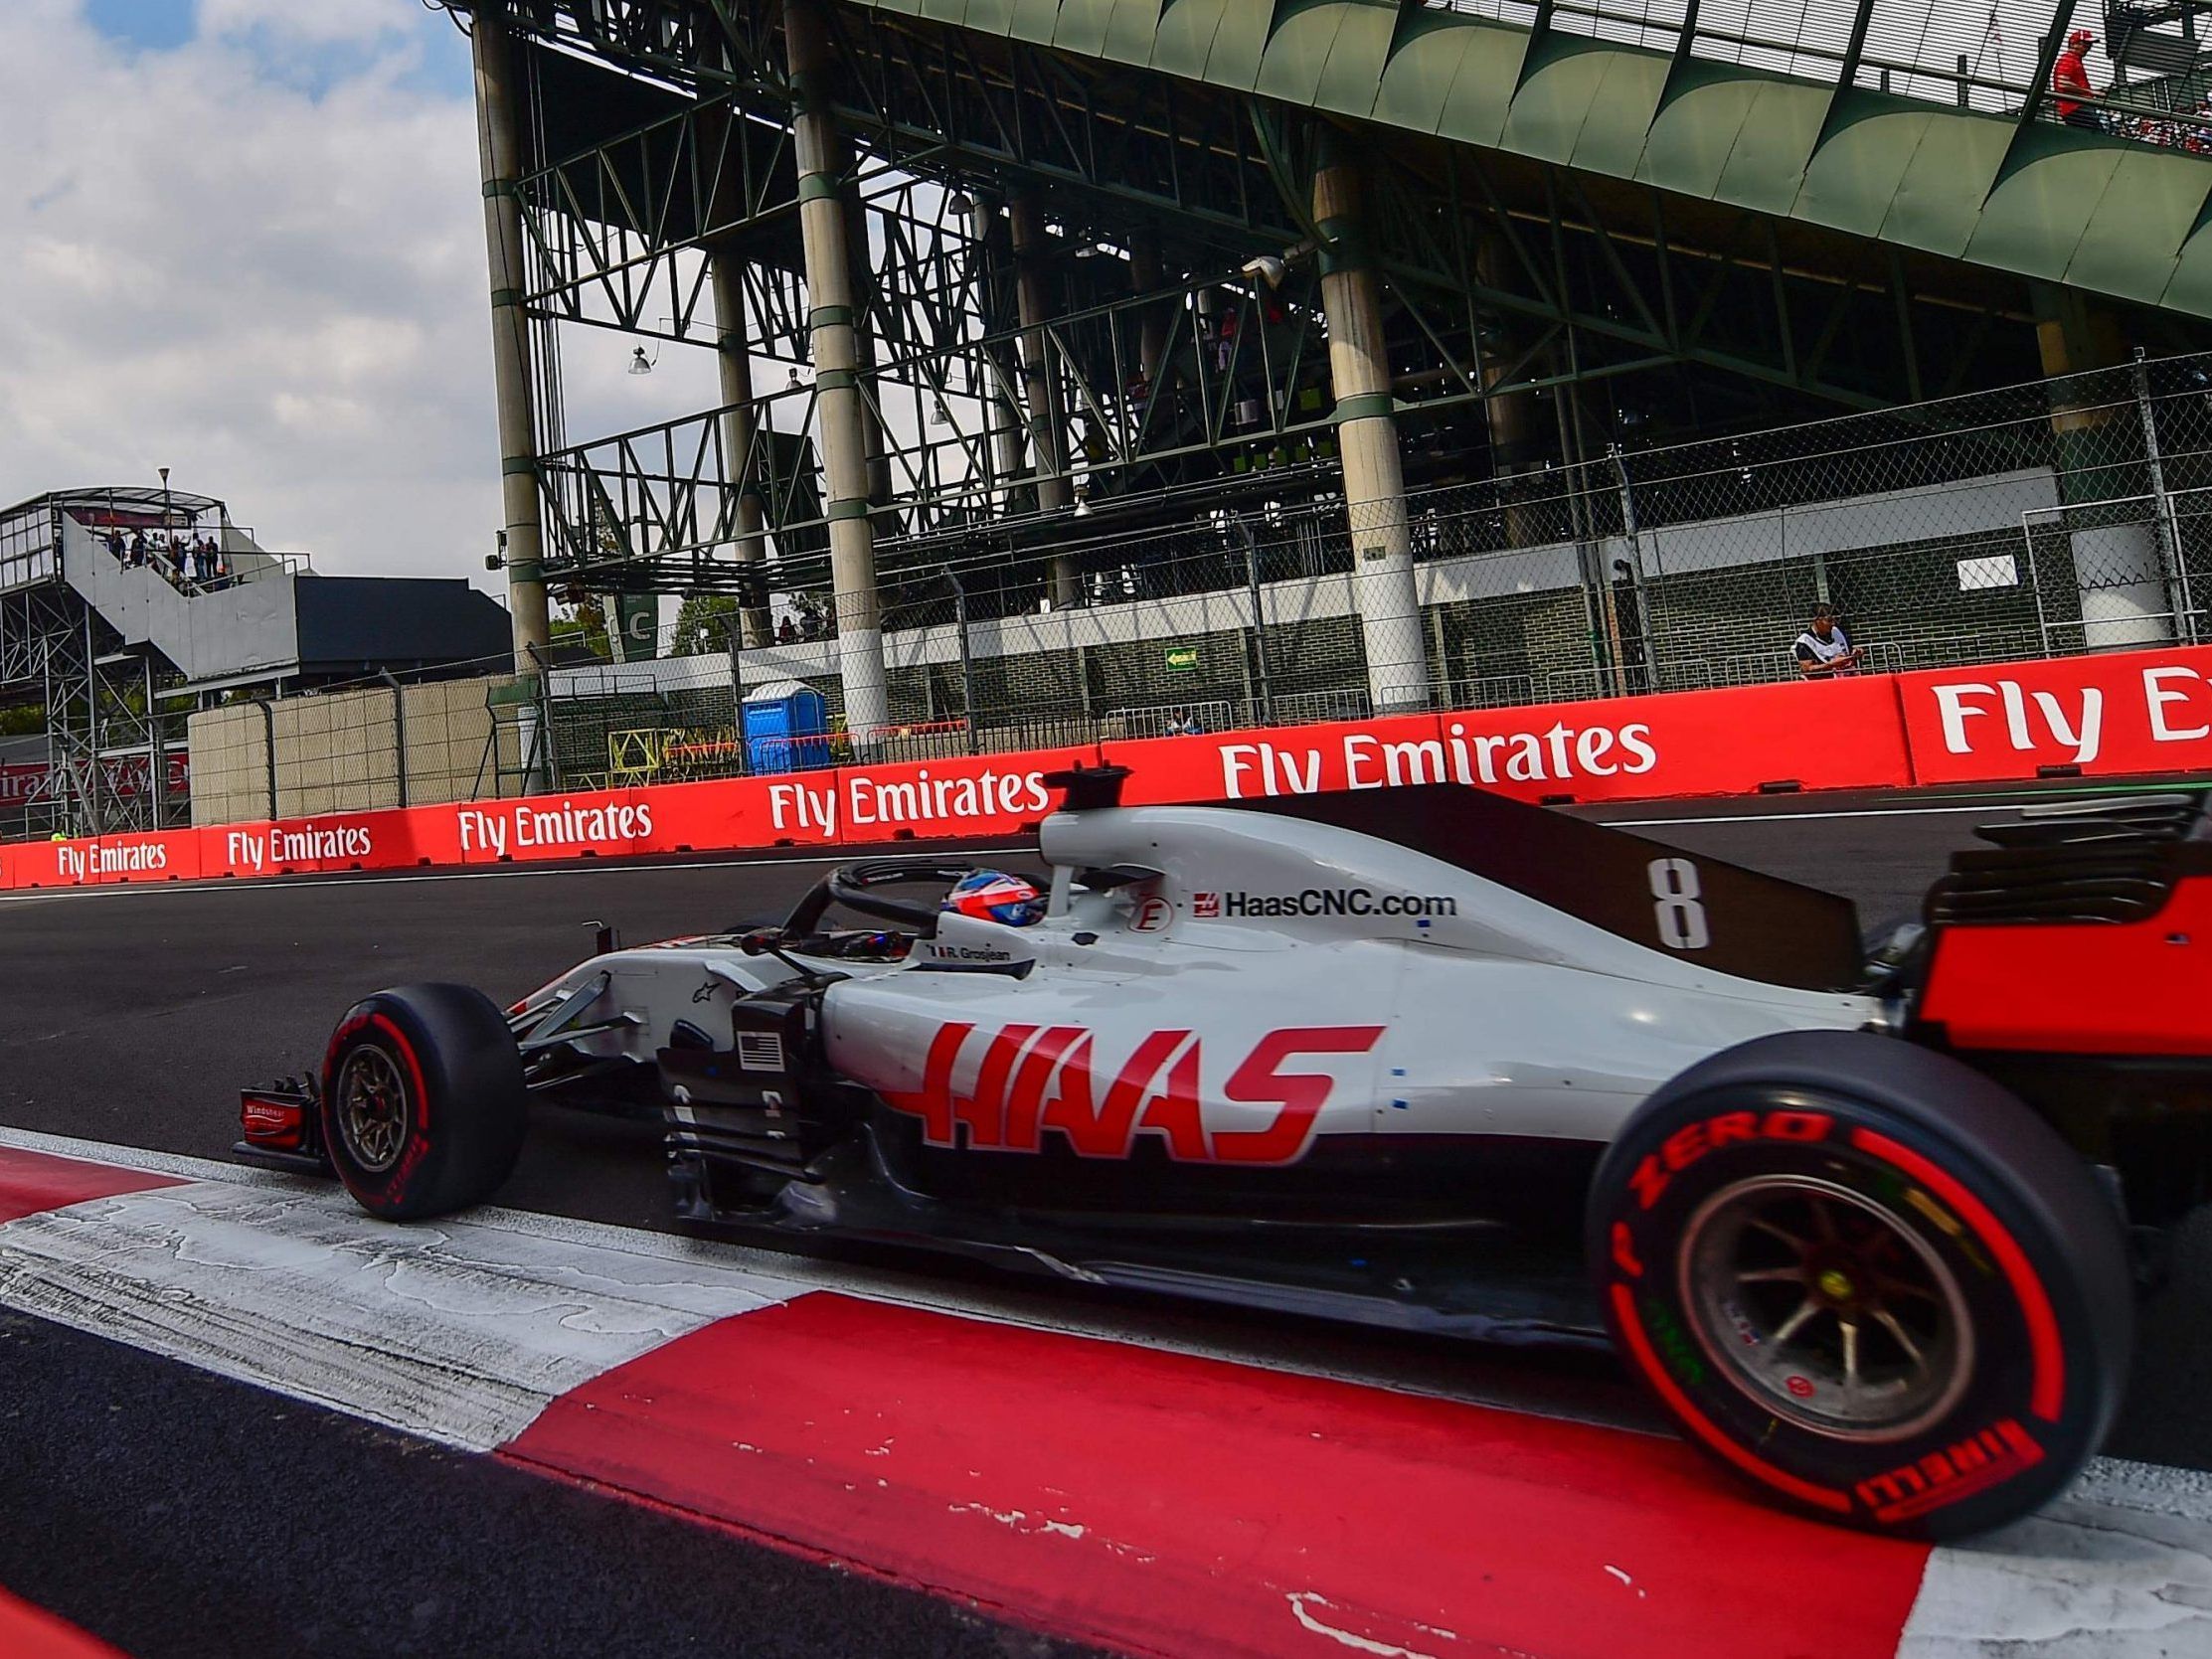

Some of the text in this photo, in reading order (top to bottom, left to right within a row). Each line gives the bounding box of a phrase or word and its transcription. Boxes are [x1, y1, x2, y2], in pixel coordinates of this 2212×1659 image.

[629, 611, 651, 640] C
[1931, 666, 2212, 763] Fly E
[1218, 720, 1657, 799] Fly Emirates
[457, 800, 654, 857] Fly Emirates
[768, 768, 1050, 838] Fly Emirates
[58, 840, 167, 881] Fly Emirates
[228, 824, 372, 872] Fly Emirates
[1224, 888, 1457, 918] HaasCNC.com
[1646, 857, 1710, 949] 8
[946, 946, 1010, 962] R. Grosjean
[877, 1022, 1388, 1166] HAAS
[1627, 1109, 1836, 1212] ZERO
[1855, 1417, 2047, 1525] PIRELLI
